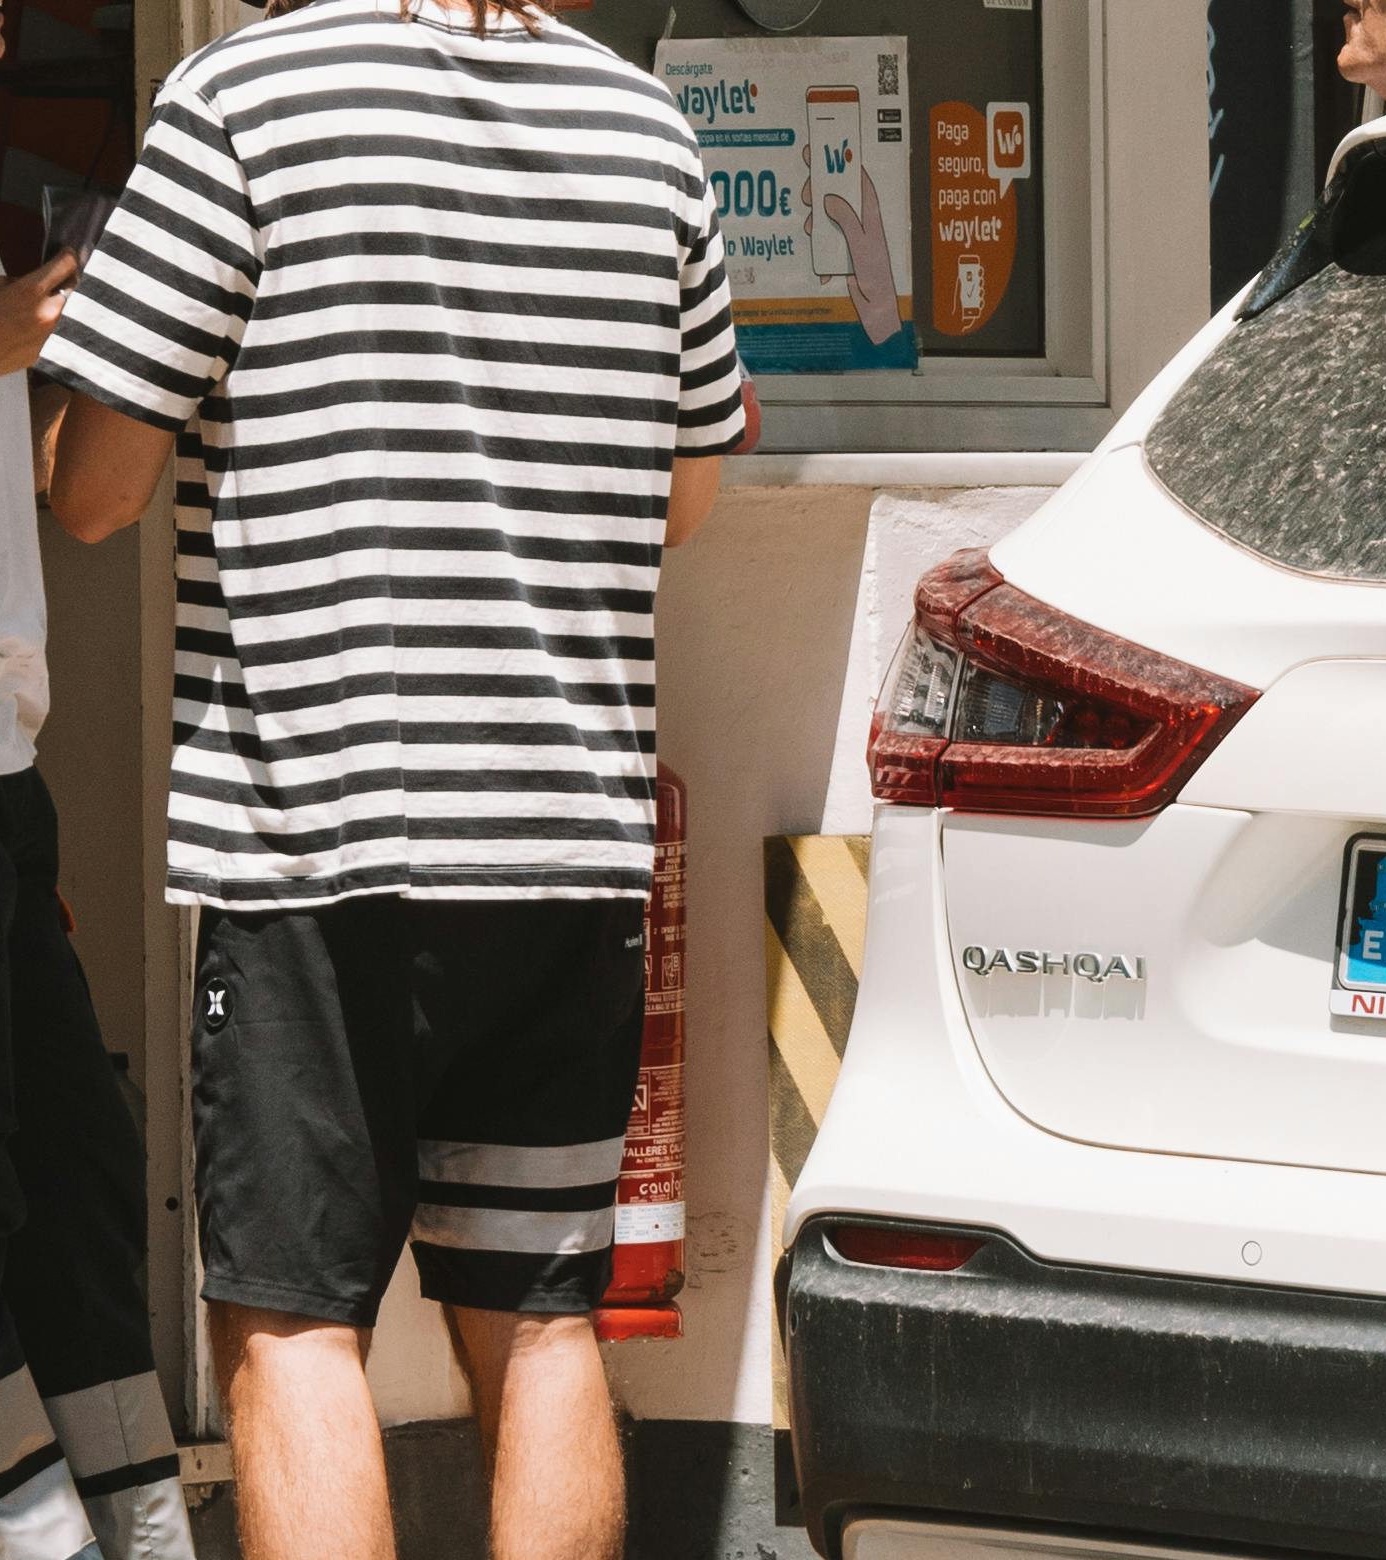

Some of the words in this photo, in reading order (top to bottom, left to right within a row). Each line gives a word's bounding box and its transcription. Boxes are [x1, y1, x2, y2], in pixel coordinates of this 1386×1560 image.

[665, 62, 713, 78] Descárgate
[937, 120, 969, 146] Paga
[937, 154, 985, 178] seguro,
[938, 188, 970, 211] paga
[973, 188, 997, 205] con
[938, 215, 1002, 249] waylet
[740, 234, 795, 262] Waylet
[1360, 929, 1384, 962] E
[961, 943, 1147, 985] QASHQAI
